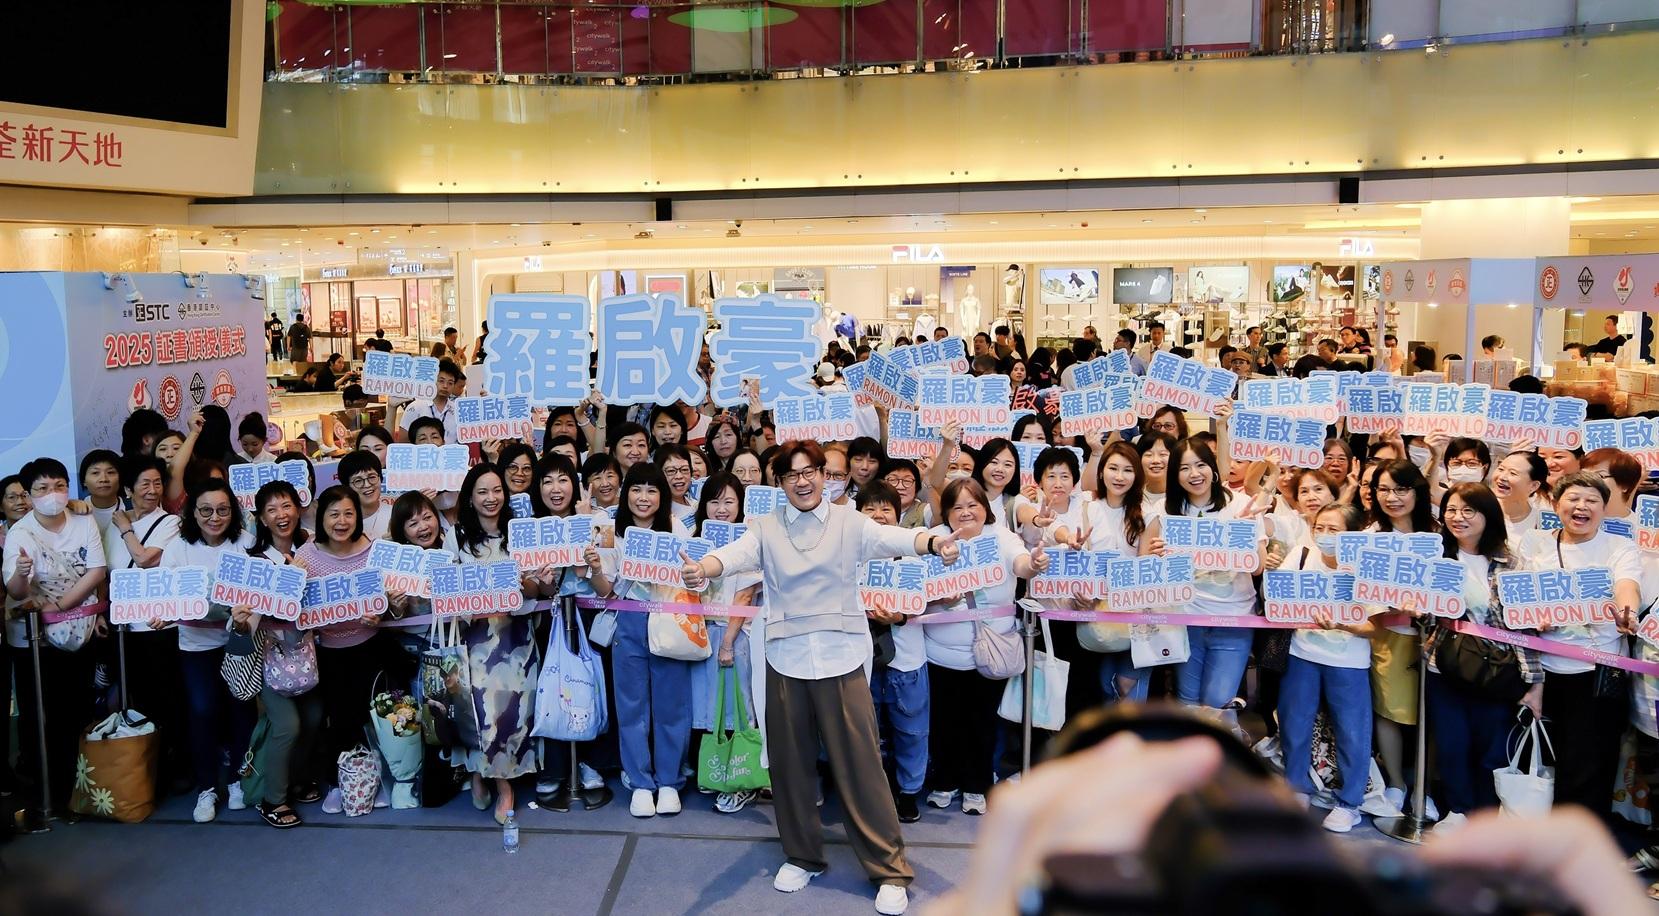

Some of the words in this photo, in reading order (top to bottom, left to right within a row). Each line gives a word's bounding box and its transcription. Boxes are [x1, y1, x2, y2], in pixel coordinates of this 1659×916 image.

[892, 246, 944, 261] FILA
[1339, 239, 1374, 256] FILA
[146, 304, 170, 321] STC
[104, 331, 152, 367] 2025
[156, 327, 246, 364] 証書頒授儀式
[490, 300, 818, 404] 羅啟豪
[367, 353, 437, 382] 羅啟豪
[866, 353, 919, 402] 羅啟豪
[951, 360, 966, 373] LO
[1151, 354, 1234, 396] 羅啟豪
[365, 378, 414, 395] RAMON
[418, 384, 435, 398] LO
[863, 379, 897, 408] RAMON
[922, 377, 1007, 405] 羅啟豪
[1062, 386, 1132, 417] 羅啟豪
[1144, 383, 1200, 410] RAMON
[1247, 379, 1332, 408] 羅啟豪
[1349, 389, 1403, 413] 羅啟
[1409, 385, 1486, 414] 羅啟豪
[457, 396, 529, 424] 羅啟豪
[776, 395, 852, 424] 羅啟豪
[922, 408, 980, 424] RAMON
[985, 408, 1007, 424] LO
[1064, 416, 1112, 434] RAMON
[1117, 412, 1134, 427] LO
[1140, 404, 1154, 416] LO
[1487, 394, 1583, 427] 羅啟豪
[459, 421, 510, 443] RAMON
[512, 421, 532, 438] LO
[779, 424, 831, 442] RAMON
[836, 422, 854, 438] LO
[1235, 412, 1323, 448] 羅啟豪
[1408, 417, 1461, 433] RAMON
[1465, 418, 1484, 434] LO
[1486, 423, 1549, 443] RAMON
[1555, 431, 1579, 447] LO
[1586, 421, 1659, 449] 羅啟
[389, 445, 468, 471] 羅啟豪
[891, 440, 937, 457] RAMON
[1234, 442, 1292, 463] RAMON
[1298, 451, 1320, 466] LO
[232, 463, 306, 492] 羅啟豪
[388, 472, 441, 488] RAMON
[511, 514, 592, 549] 羅啟豪
[1165, 518, 1256, 550] 羅啟豪
[513, 547, 570, 569] RAMON
[1234, 552, 1256, 569] LO
[1359, 550, 1464, 593] 羅啟豪
[113, 569, 205, 600] 羅啟豪
[218, 553, 304, 598] 羅啟豪
[385, 574, 418, 594] MON
[433, 560, 519, 594] 羅啟豪
[623, 560, 681, 584] RAMON
[866, 560, 924, 591] 啟豪
[926, 575, 980, 598] RAMON
[984, 566, 1004, 584] LO
[1110, 555, 1191, 589] 羅啟豪
[301, 568, 383, 609] 羅啟豪
[1034, 579, 1093, 596] RAMON
[1111, 589, 1167, 608] RAMON
[1173, 586, 1192, 601] LO
[1267, 572, 1355, 601] 羅啟豪
[1357, 582, 1427, 609] RAMON
[1435, 594, 1460, 615] LO
[1500, 568, 1614, 604] 羅啟豪
[113, 600, 178, 621] RAMON
[184, 600, 205, 616] LO
[214, 585, 272, 614] RAMON
[276, 597, 298, 618] LO
[298, 603, 359, 627] RAMON
[365, 597, 386, 613] LO
[434, 593, 494, 614] RAMON
[499, 591, 520, 609] LO
[860, 591, 897, 609] MON
[902, 594, 922, 611] LO
[1339, 605, 1364, 621] LO
[1508, 605, 1584, 625] RAMON
[1496, 631, 1529, 642] citywalk
[1583, 650, 1619, 662] citywalk
